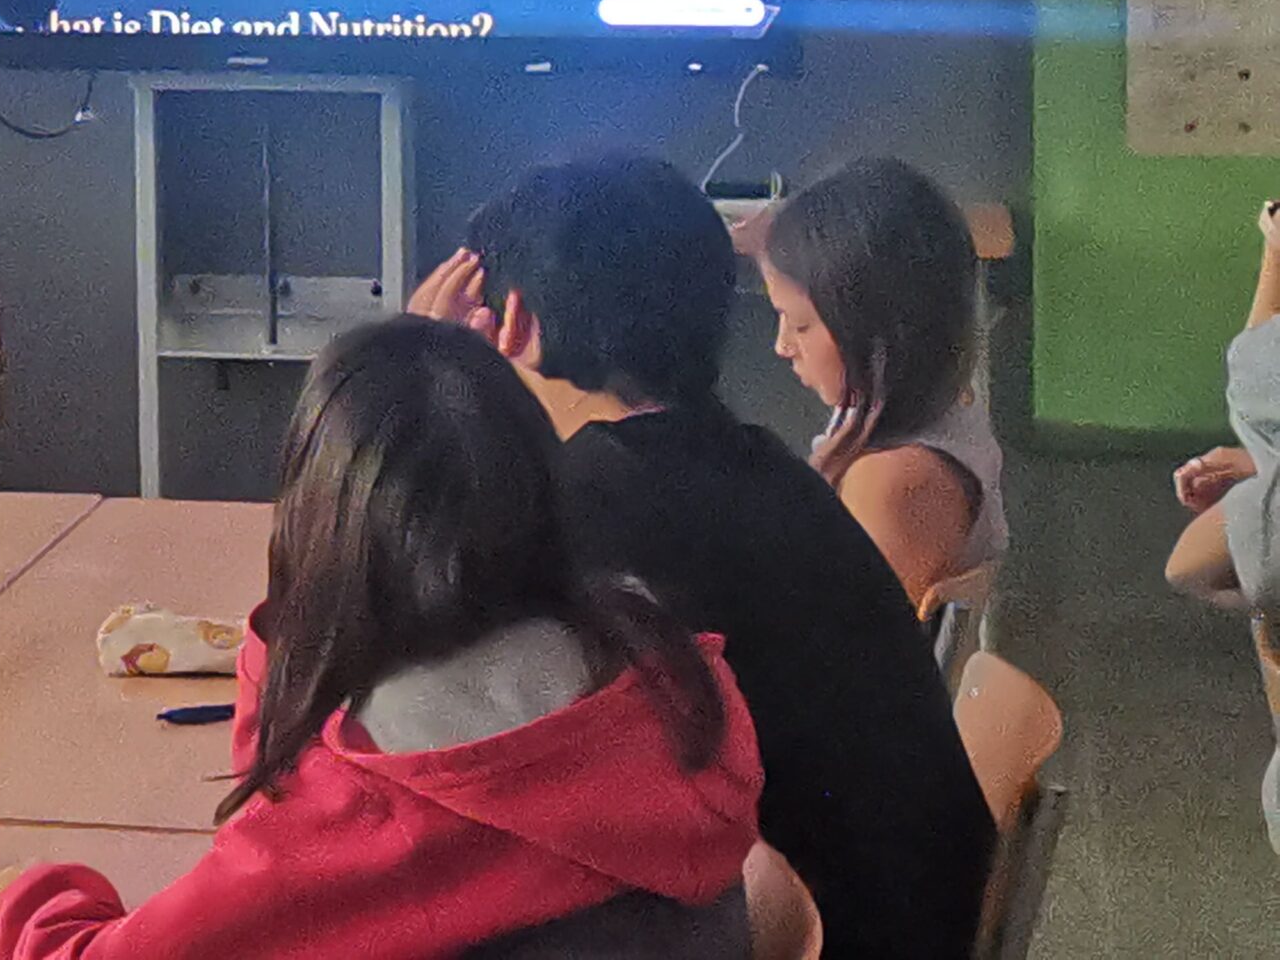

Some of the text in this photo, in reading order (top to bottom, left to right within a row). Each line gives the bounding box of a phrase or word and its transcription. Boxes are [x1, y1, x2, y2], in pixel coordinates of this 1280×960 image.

[49, 9, 105, 34] hat
[149, 9, 224, 35] Diet
[232, 11, 300, 37] and
[308, 11, 494, 39] Nutrition?
